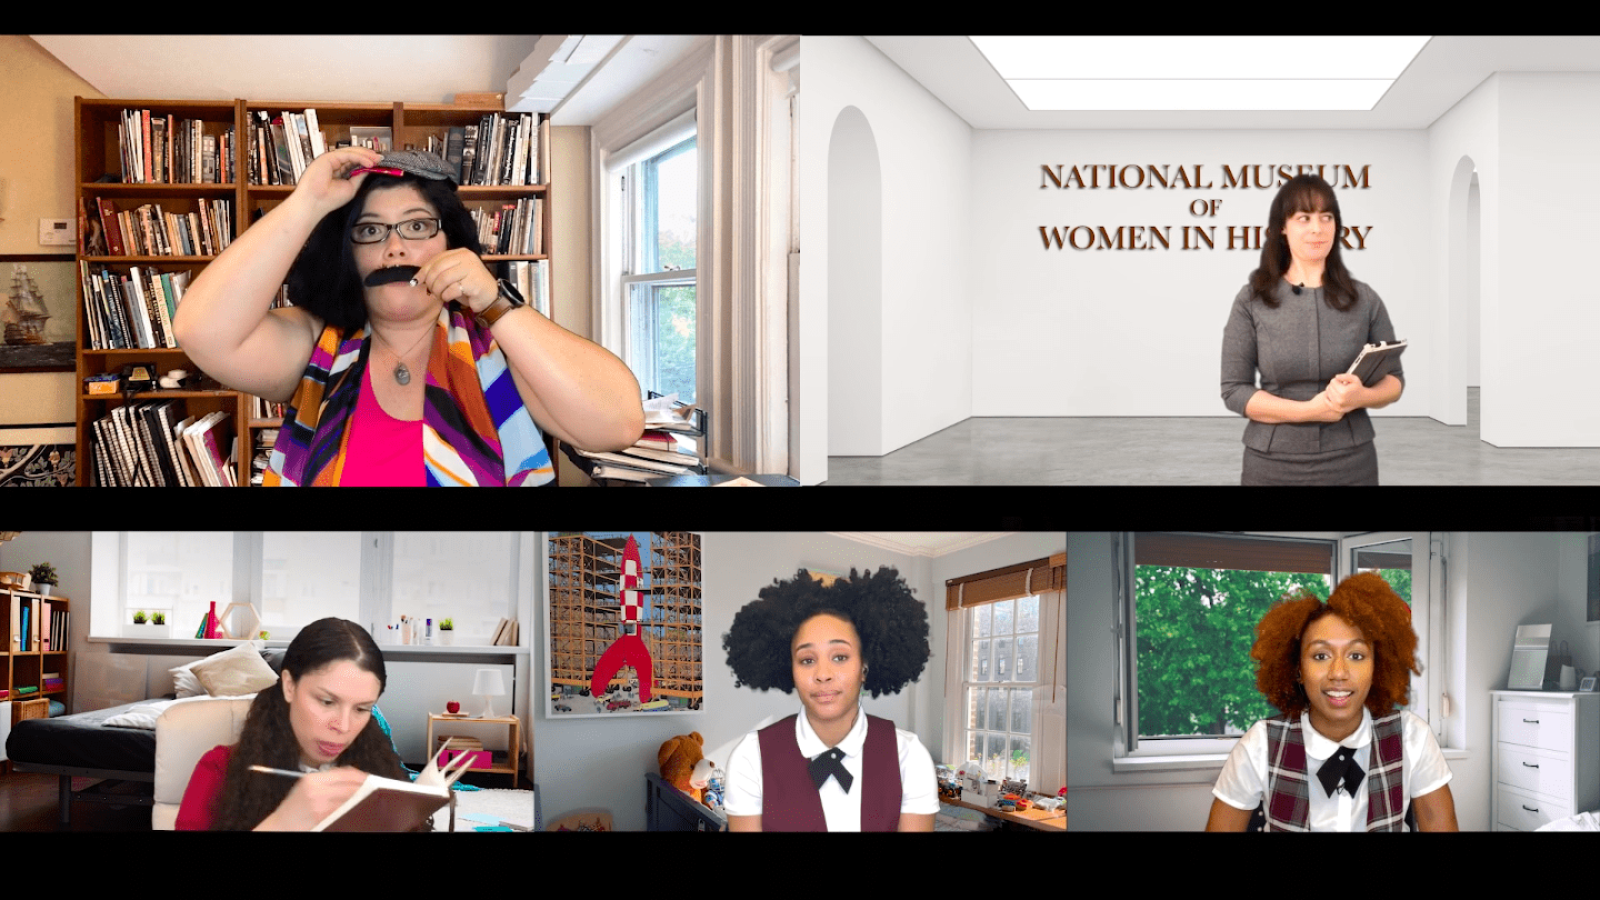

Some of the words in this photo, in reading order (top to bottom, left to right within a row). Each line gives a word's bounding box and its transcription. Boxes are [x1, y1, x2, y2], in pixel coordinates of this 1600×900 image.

[1039, 164, 1213, 190] NATIONAL
[1189, 198, 1223, 218] OF
[1038, 225, 1172, 251] WOMEN
[1181, 225, 1216, 251] IN
[1226, 225, 1373, 251] HIRY
